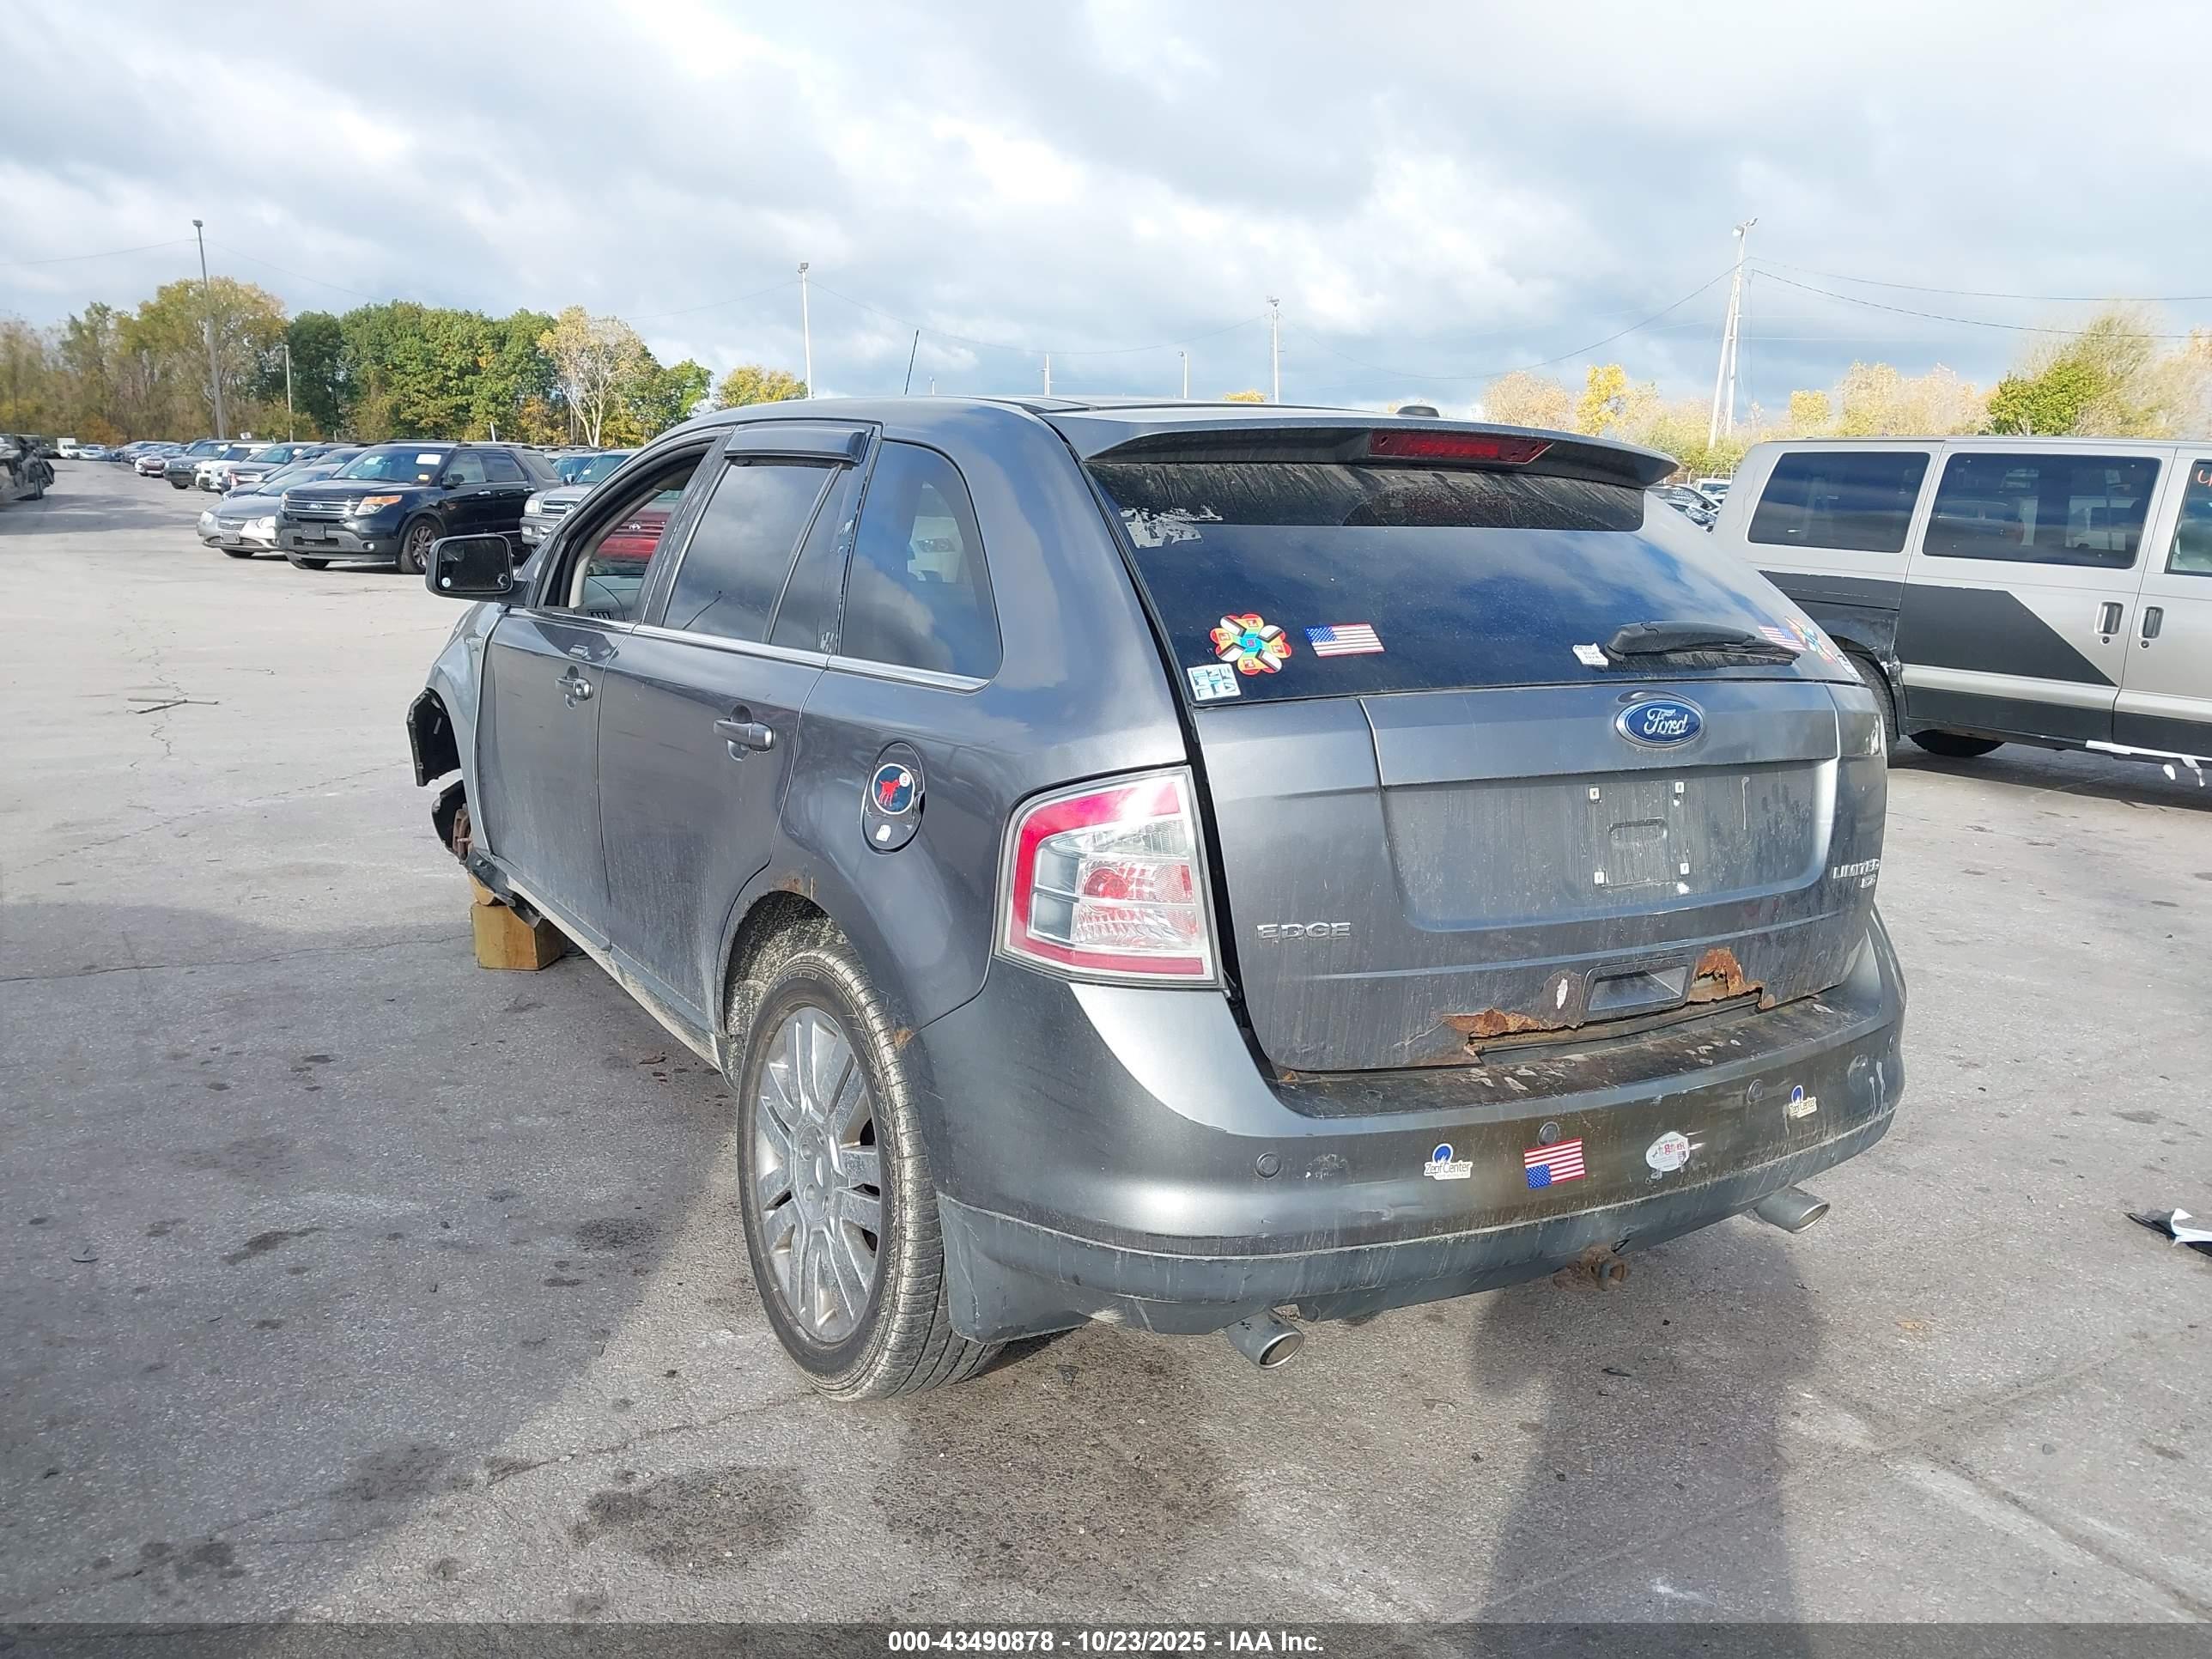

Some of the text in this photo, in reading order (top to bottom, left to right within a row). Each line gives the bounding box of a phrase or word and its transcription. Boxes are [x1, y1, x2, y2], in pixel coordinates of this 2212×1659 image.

[1644, 708, 1689, 735] Ford
[1832, 858, 1880, 879] LIMITED
[1256, 921, 1351, 939] EDGE
[1443, 1161, 1470, 1174] Center
